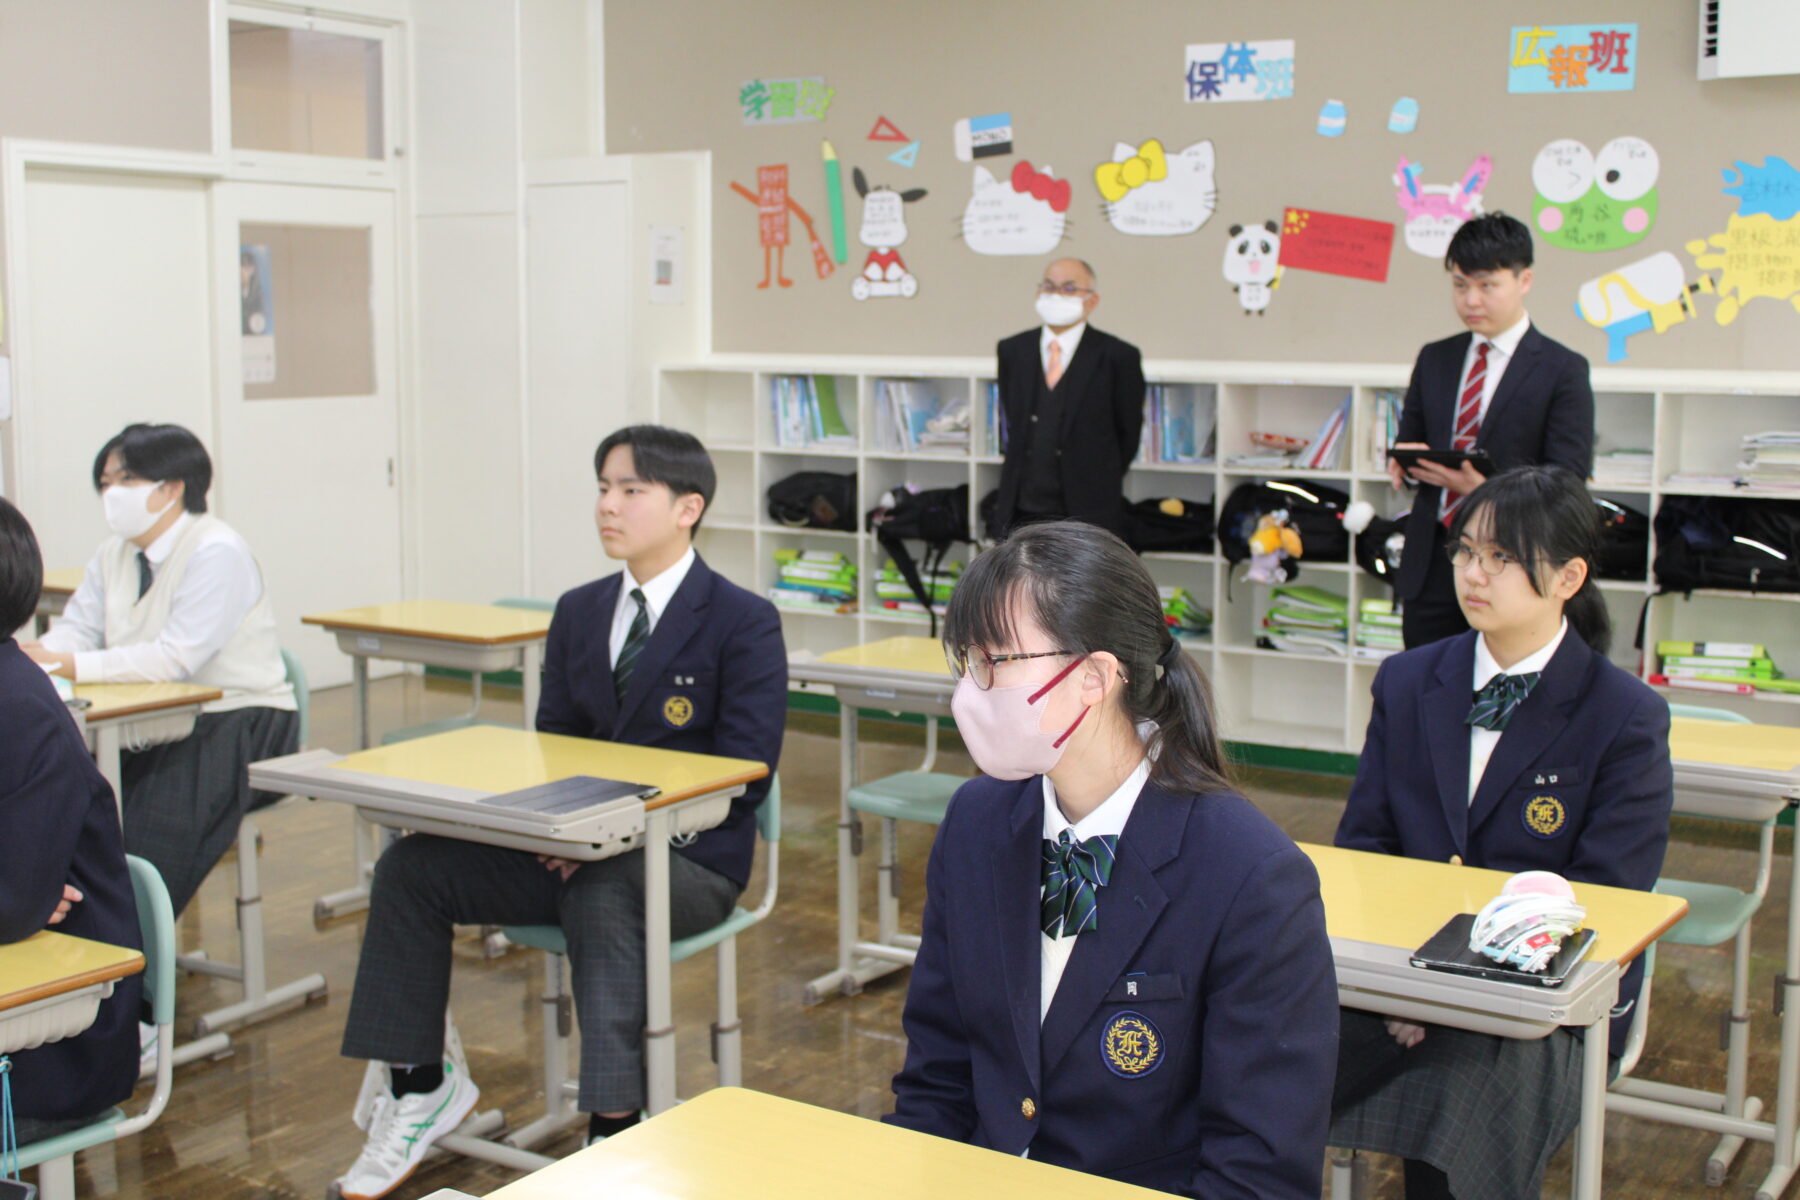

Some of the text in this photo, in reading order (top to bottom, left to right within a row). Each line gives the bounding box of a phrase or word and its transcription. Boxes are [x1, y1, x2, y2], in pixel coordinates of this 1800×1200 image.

[1185, 41, 1296, 100] 保体班
[1512, 25, 1632, 88] 広報班
